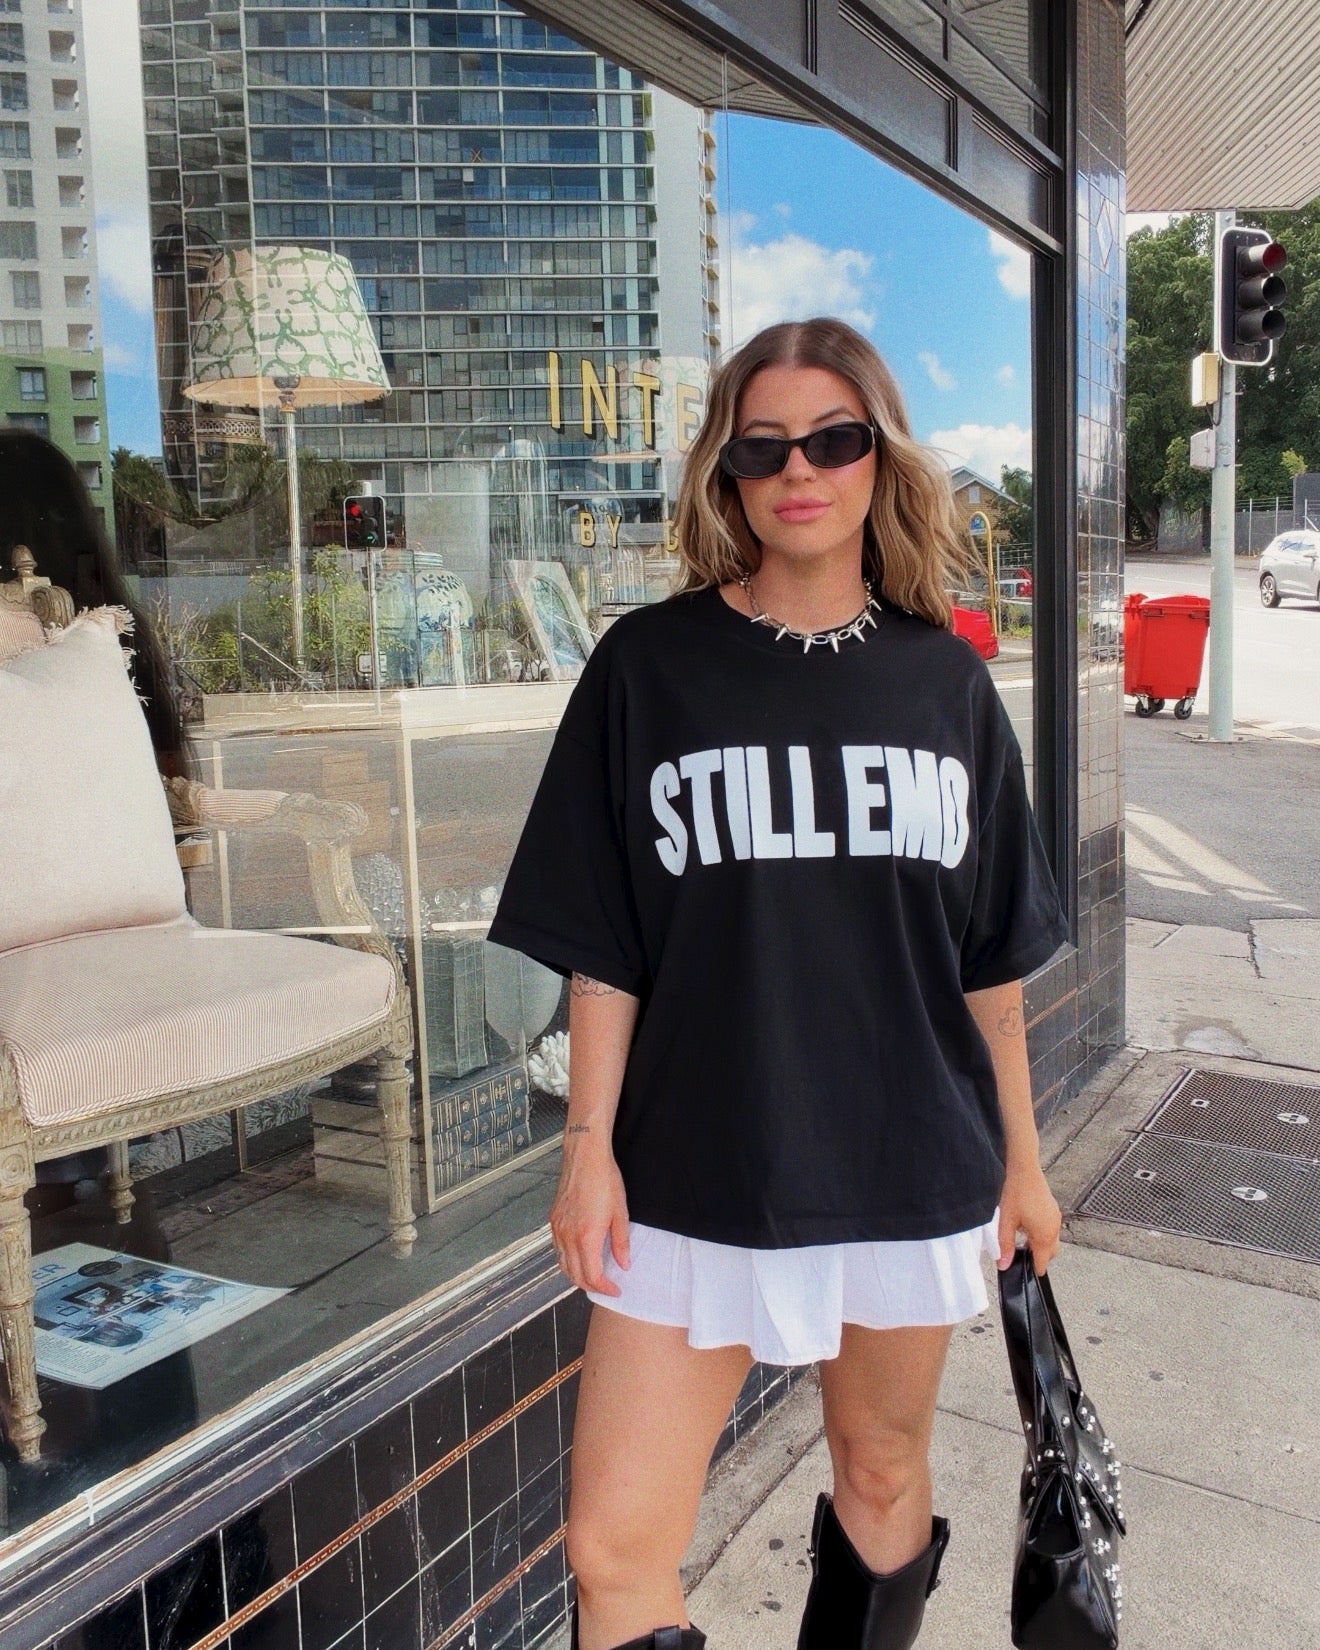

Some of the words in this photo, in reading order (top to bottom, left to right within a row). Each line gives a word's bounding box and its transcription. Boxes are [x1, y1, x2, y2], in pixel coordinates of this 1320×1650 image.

[579, 512, 621, 549] BY
[650, 746, 835, 876] STILL
[841, 745, 969, 869] EMO
